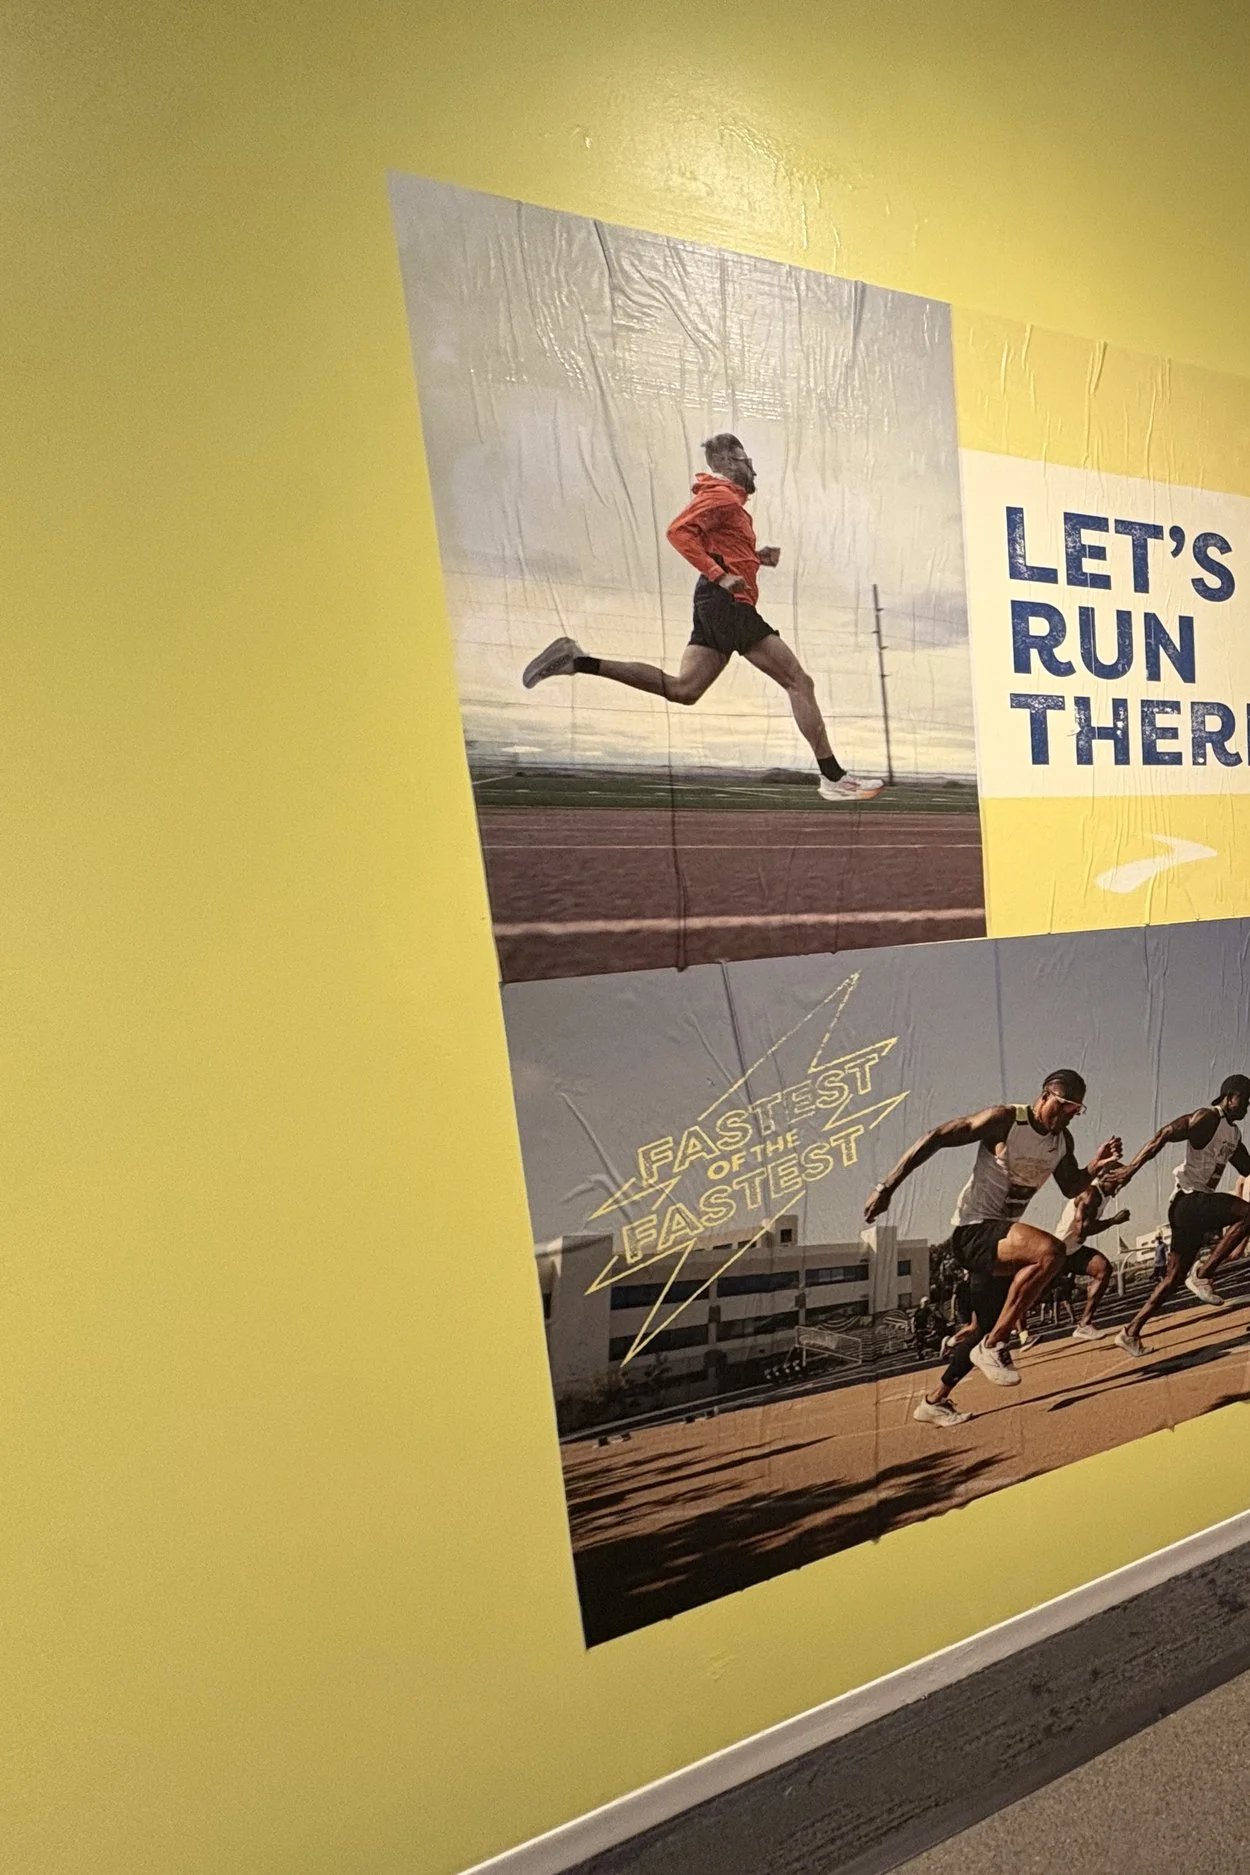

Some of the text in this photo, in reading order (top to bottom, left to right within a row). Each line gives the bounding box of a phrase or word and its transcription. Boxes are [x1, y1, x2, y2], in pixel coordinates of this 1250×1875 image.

[1005, 506, 1236, 603] LET’S
[1010, 599, 1197, 684] RUN
[637, 1051, 880, 1183] FASTEST
[707, 1129, 801, 1180] OF THE
[621, 1126, 865, 1264] FASTEST
